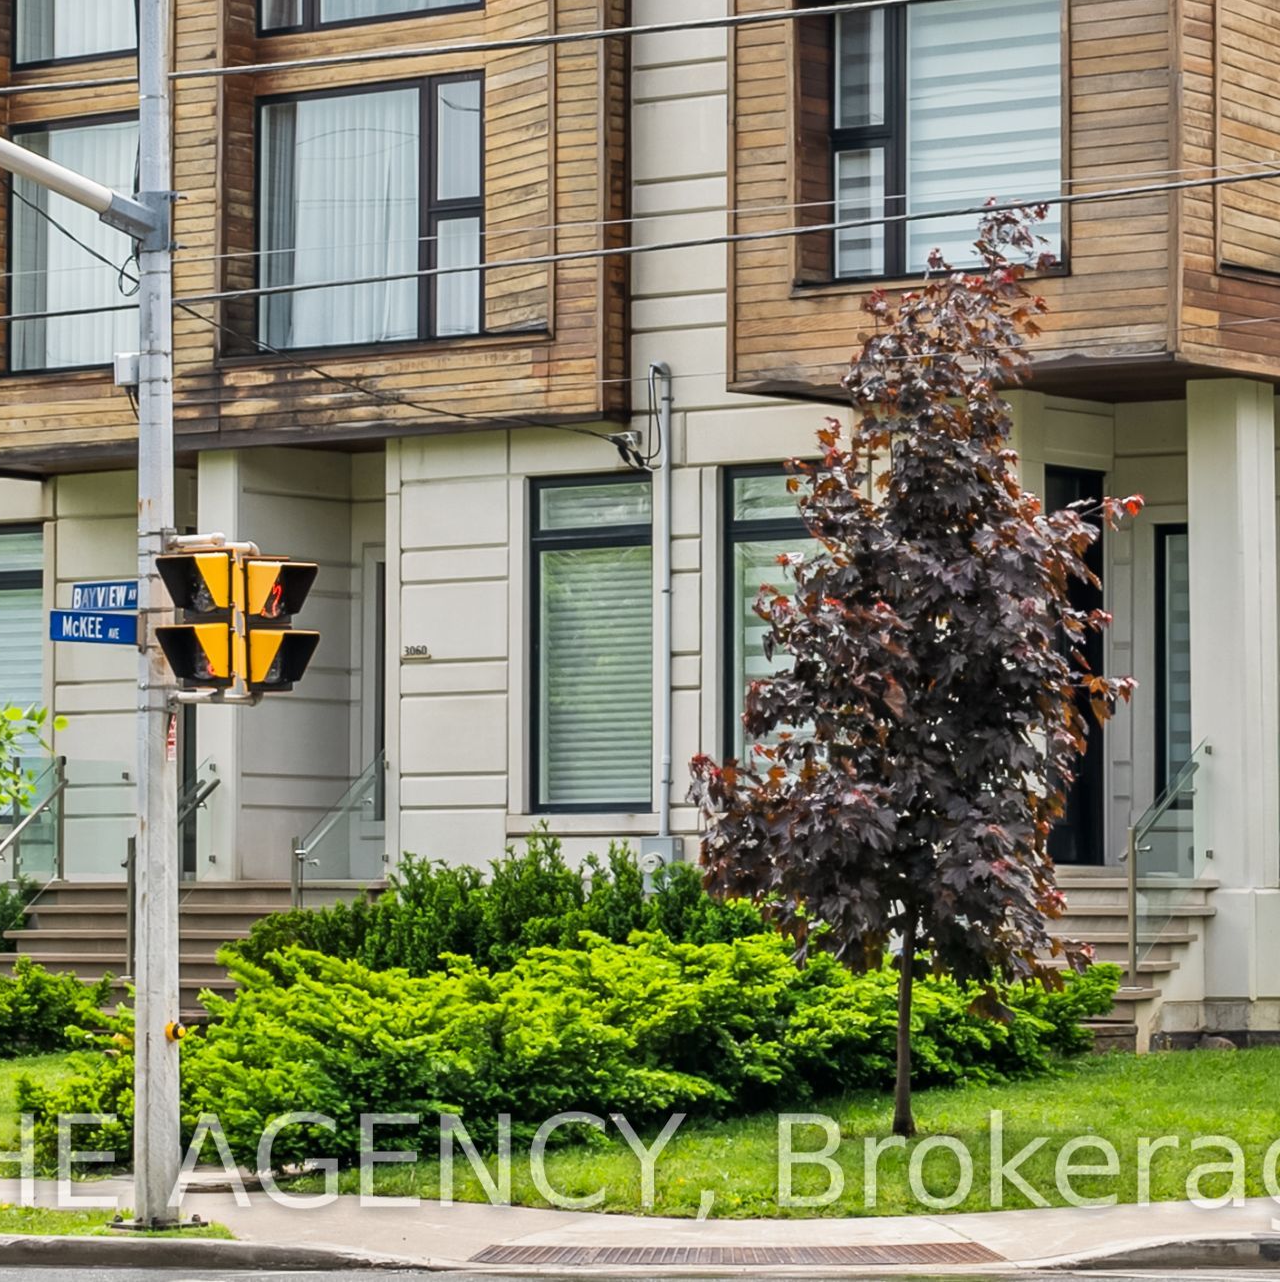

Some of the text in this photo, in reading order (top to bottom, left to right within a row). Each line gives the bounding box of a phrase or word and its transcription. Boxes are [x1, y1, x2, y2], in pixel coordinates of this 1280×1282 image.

[73, 585, 127, 609] BAYVIEW
[62, 615, 119, 639] McKEE AVE
[404, 646, 427, 655] 3060
